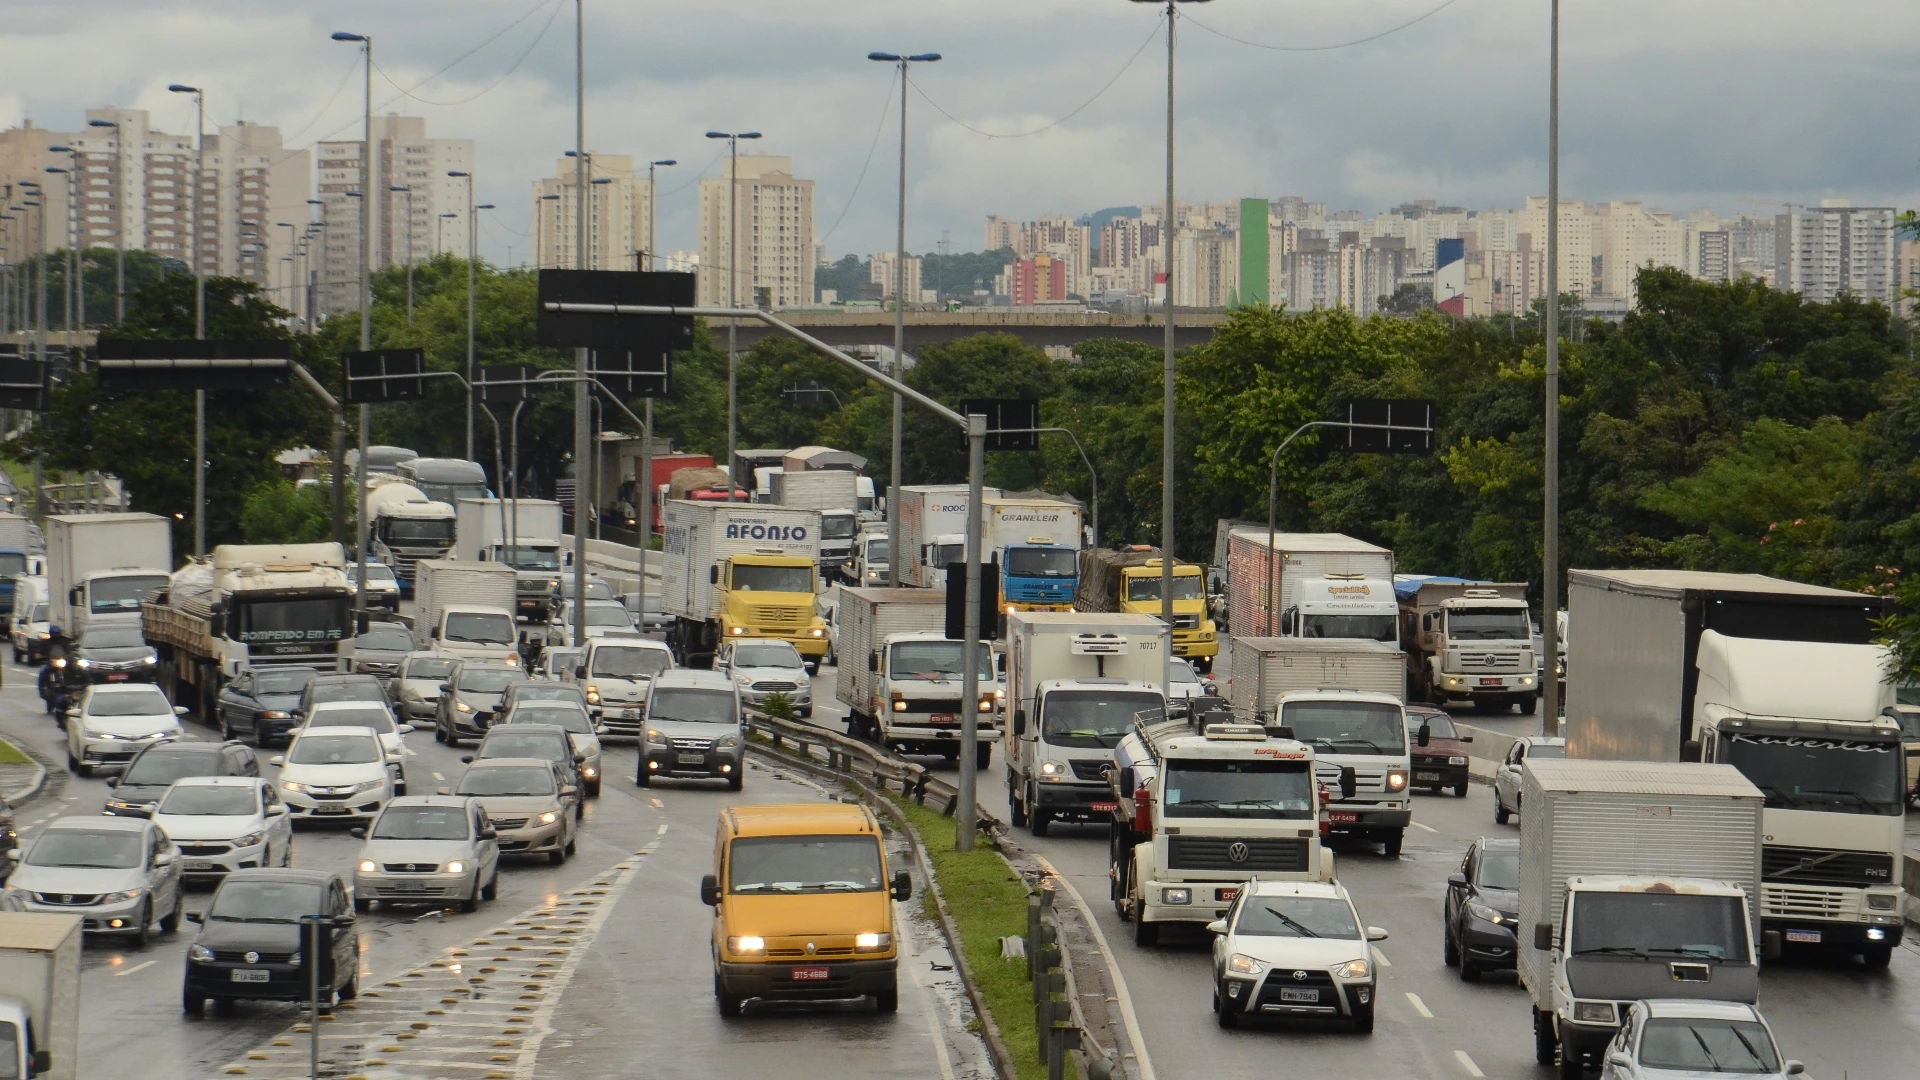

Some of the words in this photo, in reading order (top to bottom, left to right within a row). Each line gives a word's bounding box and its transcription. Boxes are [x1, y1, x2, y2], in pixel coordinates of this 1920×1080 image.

[1001, 514, 1059, 522] GRANELEIR
[726, 524, 807, 541] AFONSO
[240, 630, 304, 640] ROMPENDO
[307, 630, 325, 639] EM
[1139, 642, 1157, 650] 70717
[1865, 868, 1887, 877] FH12
